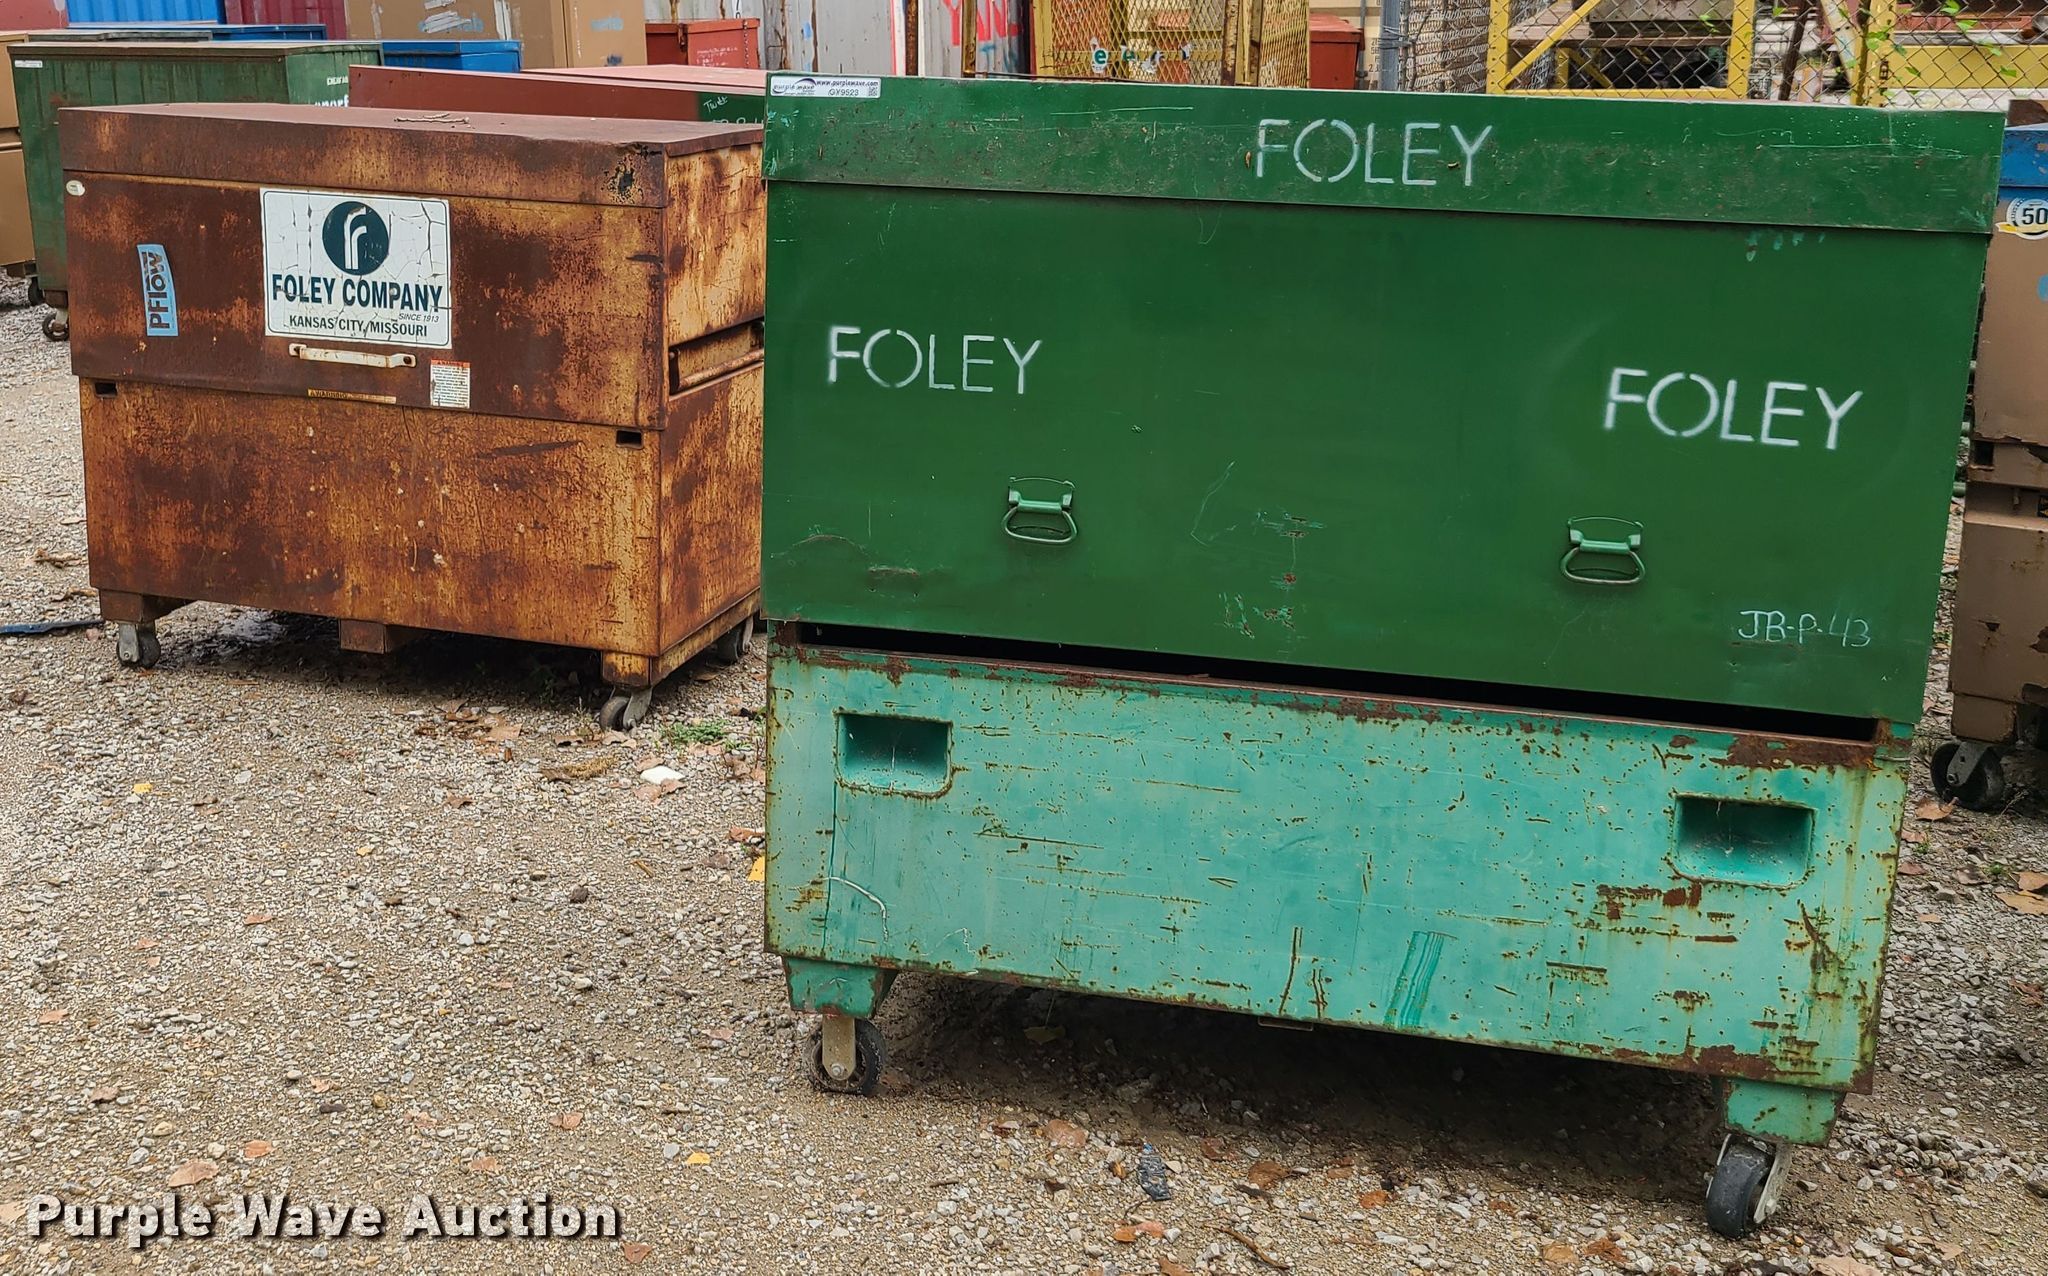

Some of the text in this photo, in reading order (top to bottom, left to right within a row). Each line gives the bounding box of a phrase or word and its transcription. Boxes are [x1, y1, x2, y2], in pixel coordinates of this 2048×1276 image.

[1256, 118, 1493, 187] FOLEY
[272, 273, 443, 313] FOLEY COMPANY
[399, 313, 439, 323] SINCE 1913
[289, 315, 334, 329] KANSAS
[370, 320, 427, 337] MISSOURI
[828, 326, 1042, 394] FOLEY
[1604, 367, 1863, 450] FOLEY
